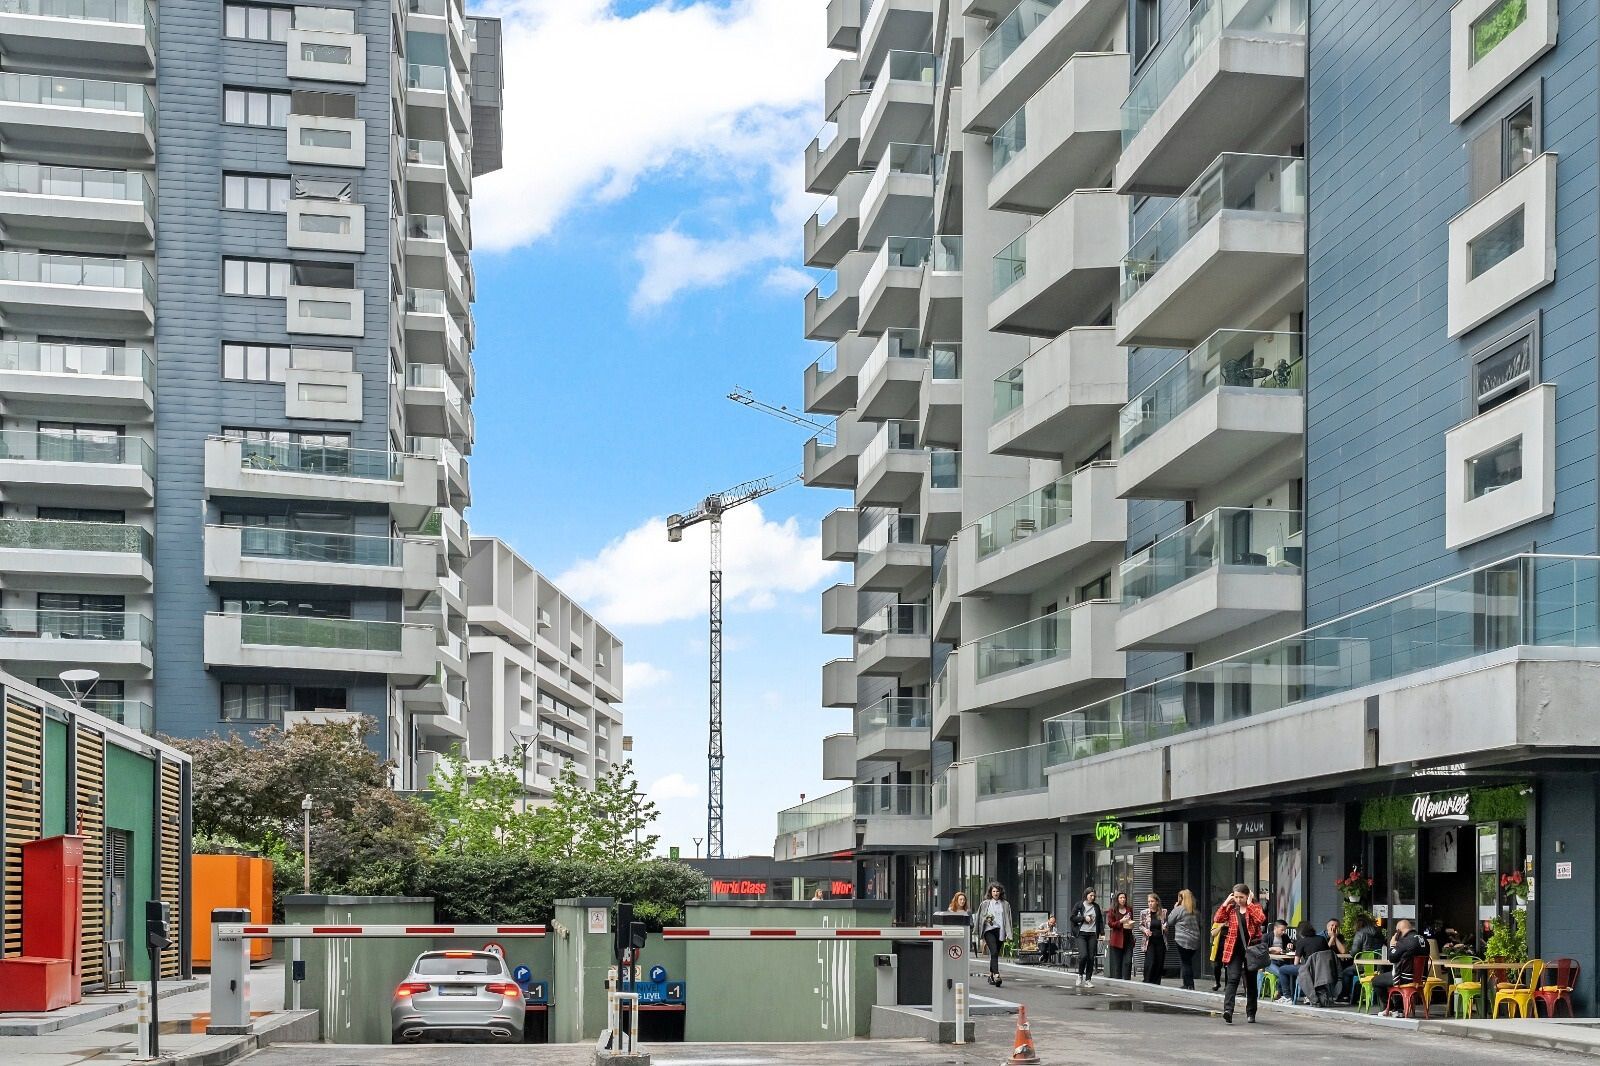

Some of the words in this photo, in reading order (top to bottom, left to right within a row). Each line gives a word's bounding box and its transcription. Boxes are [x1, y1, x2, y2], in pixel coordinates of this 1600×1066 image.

[1411, 794, 1469, 822] Memories
[1244, 821, 1264, 833] AZUR
[712, 880, 740, 894] World
[741, 881, 767, 894] Class
[529, 985, 542, 998] -1
[668, 985, 680, 998] -1
